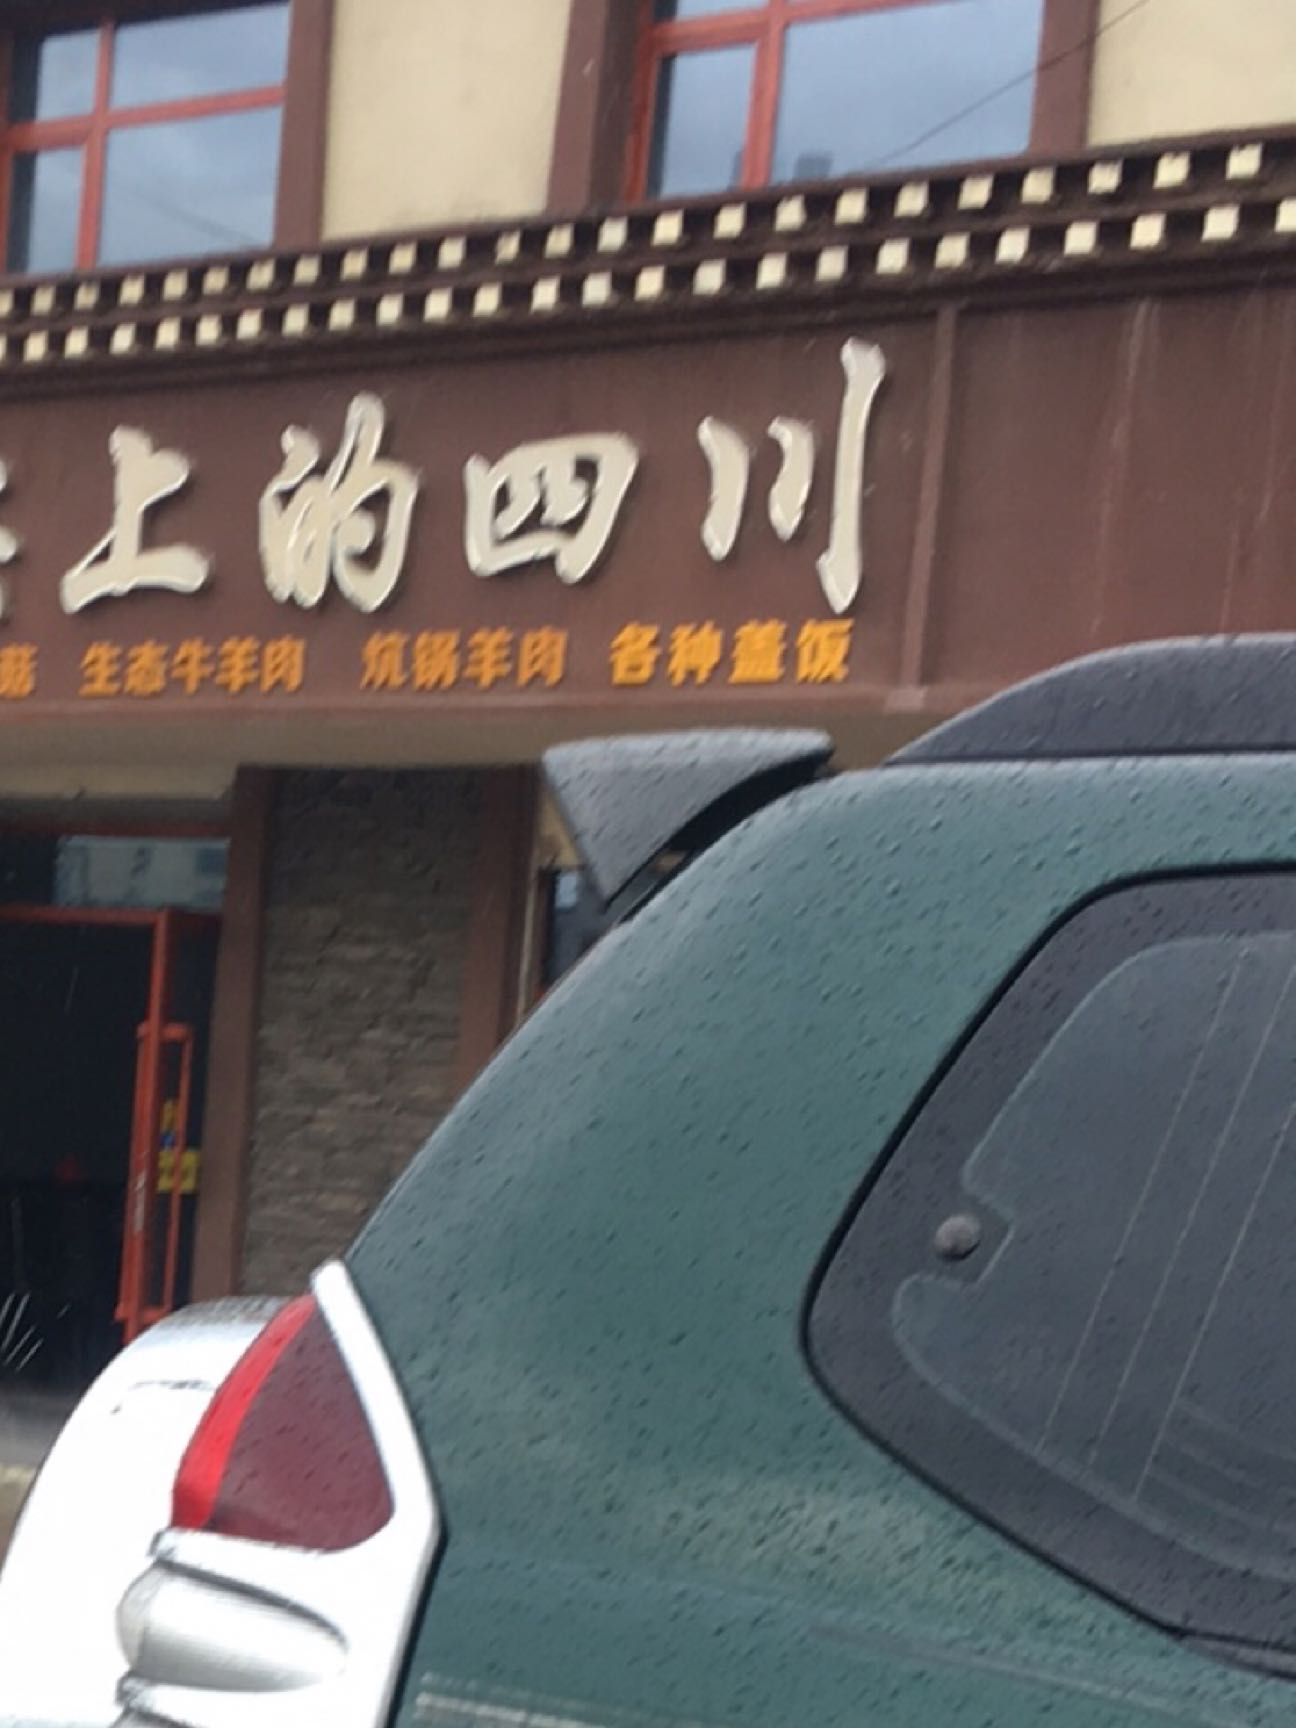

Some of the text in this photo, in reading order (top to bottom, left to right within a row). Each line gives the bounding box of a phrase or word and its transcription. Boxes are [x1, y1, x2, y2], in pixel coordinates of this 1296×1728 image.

[79, 634, 307, 697] 生态牛羊肉
[610, 618, 855, 686] 各种盖饭
